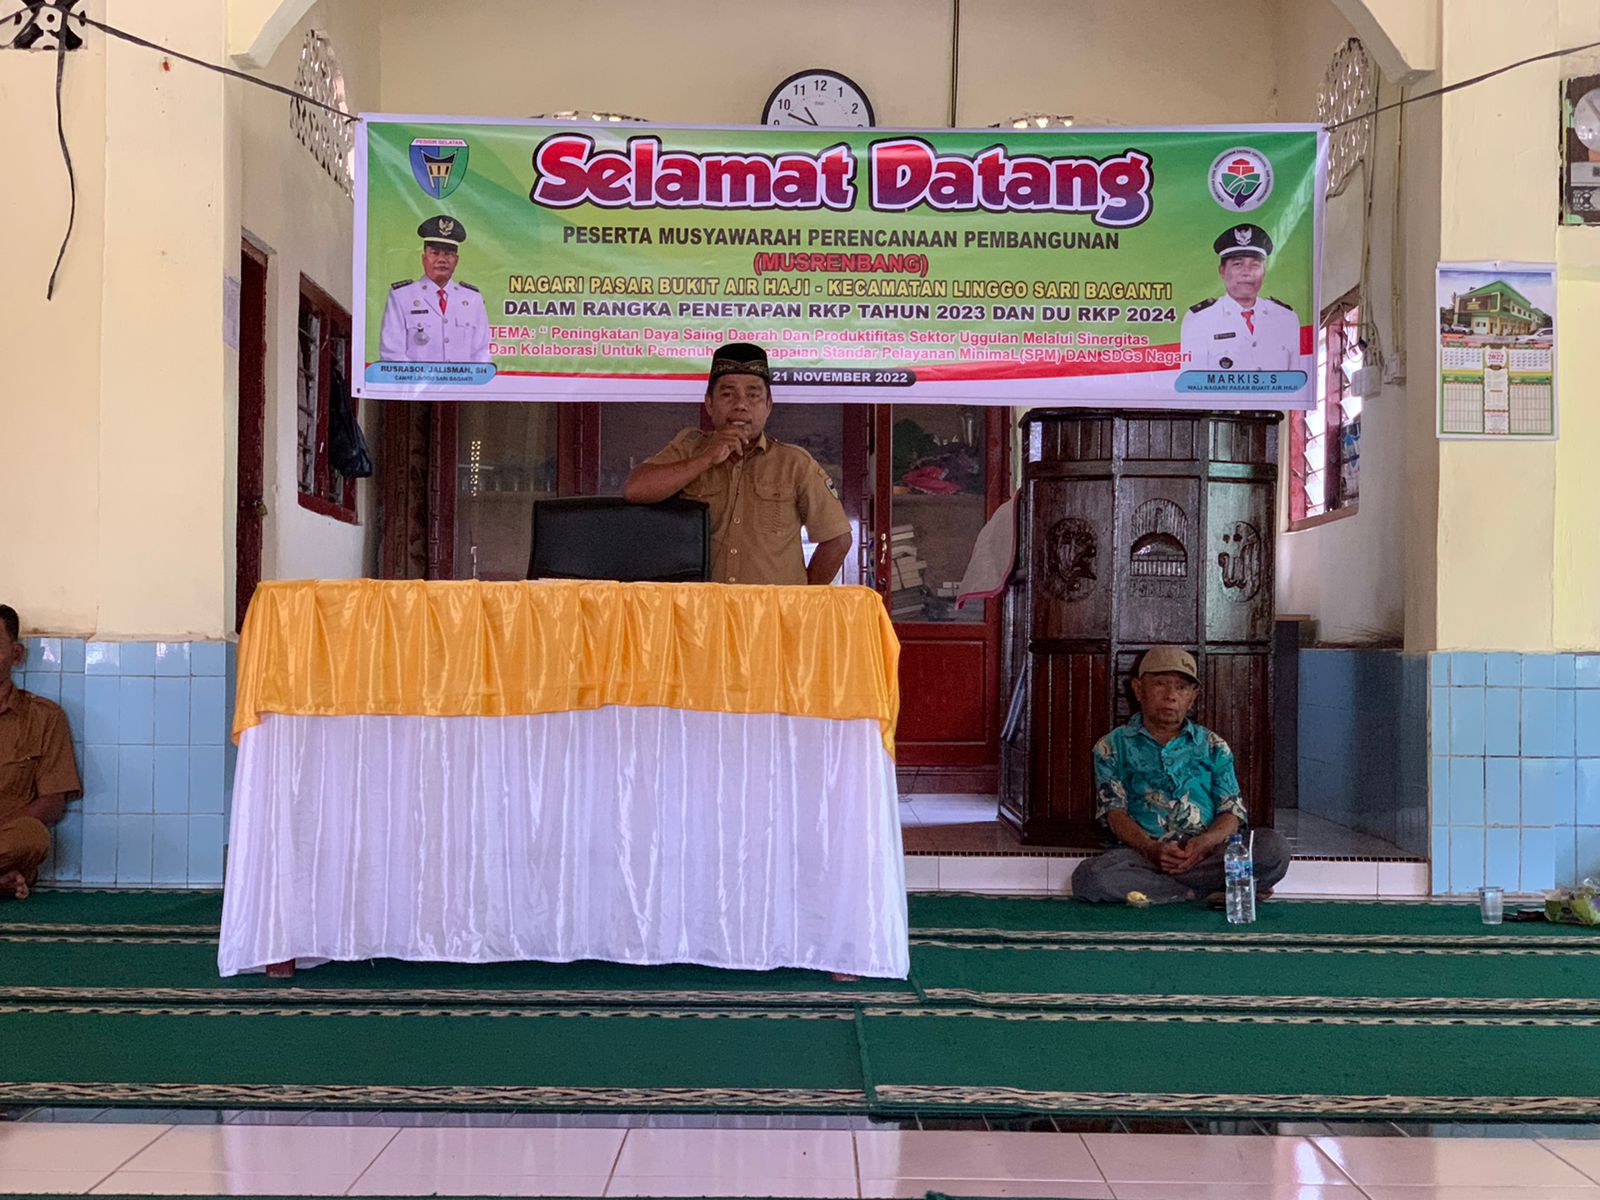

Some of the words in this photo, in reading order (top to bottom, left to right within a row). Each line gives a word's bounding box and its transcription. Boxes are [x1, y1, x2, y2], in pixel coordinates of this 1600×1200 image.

[793, 84, 805, 96] 11
[814, 80, 827, 91] 12
[838, 87, 843, 98] 1
[778, 99, 791, 110] 10
[851, 103, 859, 114] 2
[530, 132, 858, 211] Selamat
[868, 136, 1154, 229] Datang
[563, 226, 653, 245] PESERTA
[659, 227, 801, 246] MUSYAWARAH
[808, 229, 958, 248] PERENCANAAN
[964, 231, 1119, 250] PEMBANGUNAN
[753, 252, 929, 277] (MUSRENBANG)
[509, 275, 584, 293] NAGARI
[589, 276, 653, 294] PASAR
[658, 277, 720, 295] BUKIT
[724, 278, 759, 295] AIR
[763, 278, 810, 296] HAJI
[827, 278, 947, 297] KECAMATAN
[952, 279, 1029, 298] LINGGO
[1033, 280, 1079, 299] SARI
[1084, 281, 1173, 300] BAGANTI
[504, 301, 576, 316] DALAM
[583, 301, 671, 316] RANGKA
[678, 302, 801, 317] PENETAPAN
[808, 303, 851, 318] RKP
[858, 304, 929, 319] TAHUN
[936, 305, 986, 320] 2023
[992, 306, 1035, 321] DAN
[1042, 307, 1070, 321] DU
[1078, 307, 1121, 321] RKP
[1127, 307, 1177, 322] 2024
[489, 326, 536, 339] TEMA:
[551, 327, 639, 342] Peningkatan
[644, 328, 679, 342] Daya
[684, 328, 724, 343] Saing
[728, 329, 778, 341] Daerah
[782, 329, 810, 341] Dan
[815, 329, 905, 342] Produktifitas
[909, 331, 955, 343] Sektor
[960, 332, 1018, 346] Uggulan
[1023, 333, 1073, 344] Melalui
[1078, 333, 1149, 347] Sinergitas
[489, 343, 516, 355] Dan
[521, 343, 597, 356] Kolaborasi
[602, 344, 643, 356] Untuk
[648, 344, 714, 357] Pemenuh
[823, 347, 878, 358] Standar
[882, 347, 955, 360] Pelayanan
[1066, 350, 1100, 361] DAN
[1102, 350, 1141, 362] SDGs
[1147, 350, 1192, 365] Nagari
[772, 371, 788, 381] 21
[793, 371, 871, 382] NOVEMBER
[876, 372, 908, 383] 2022
